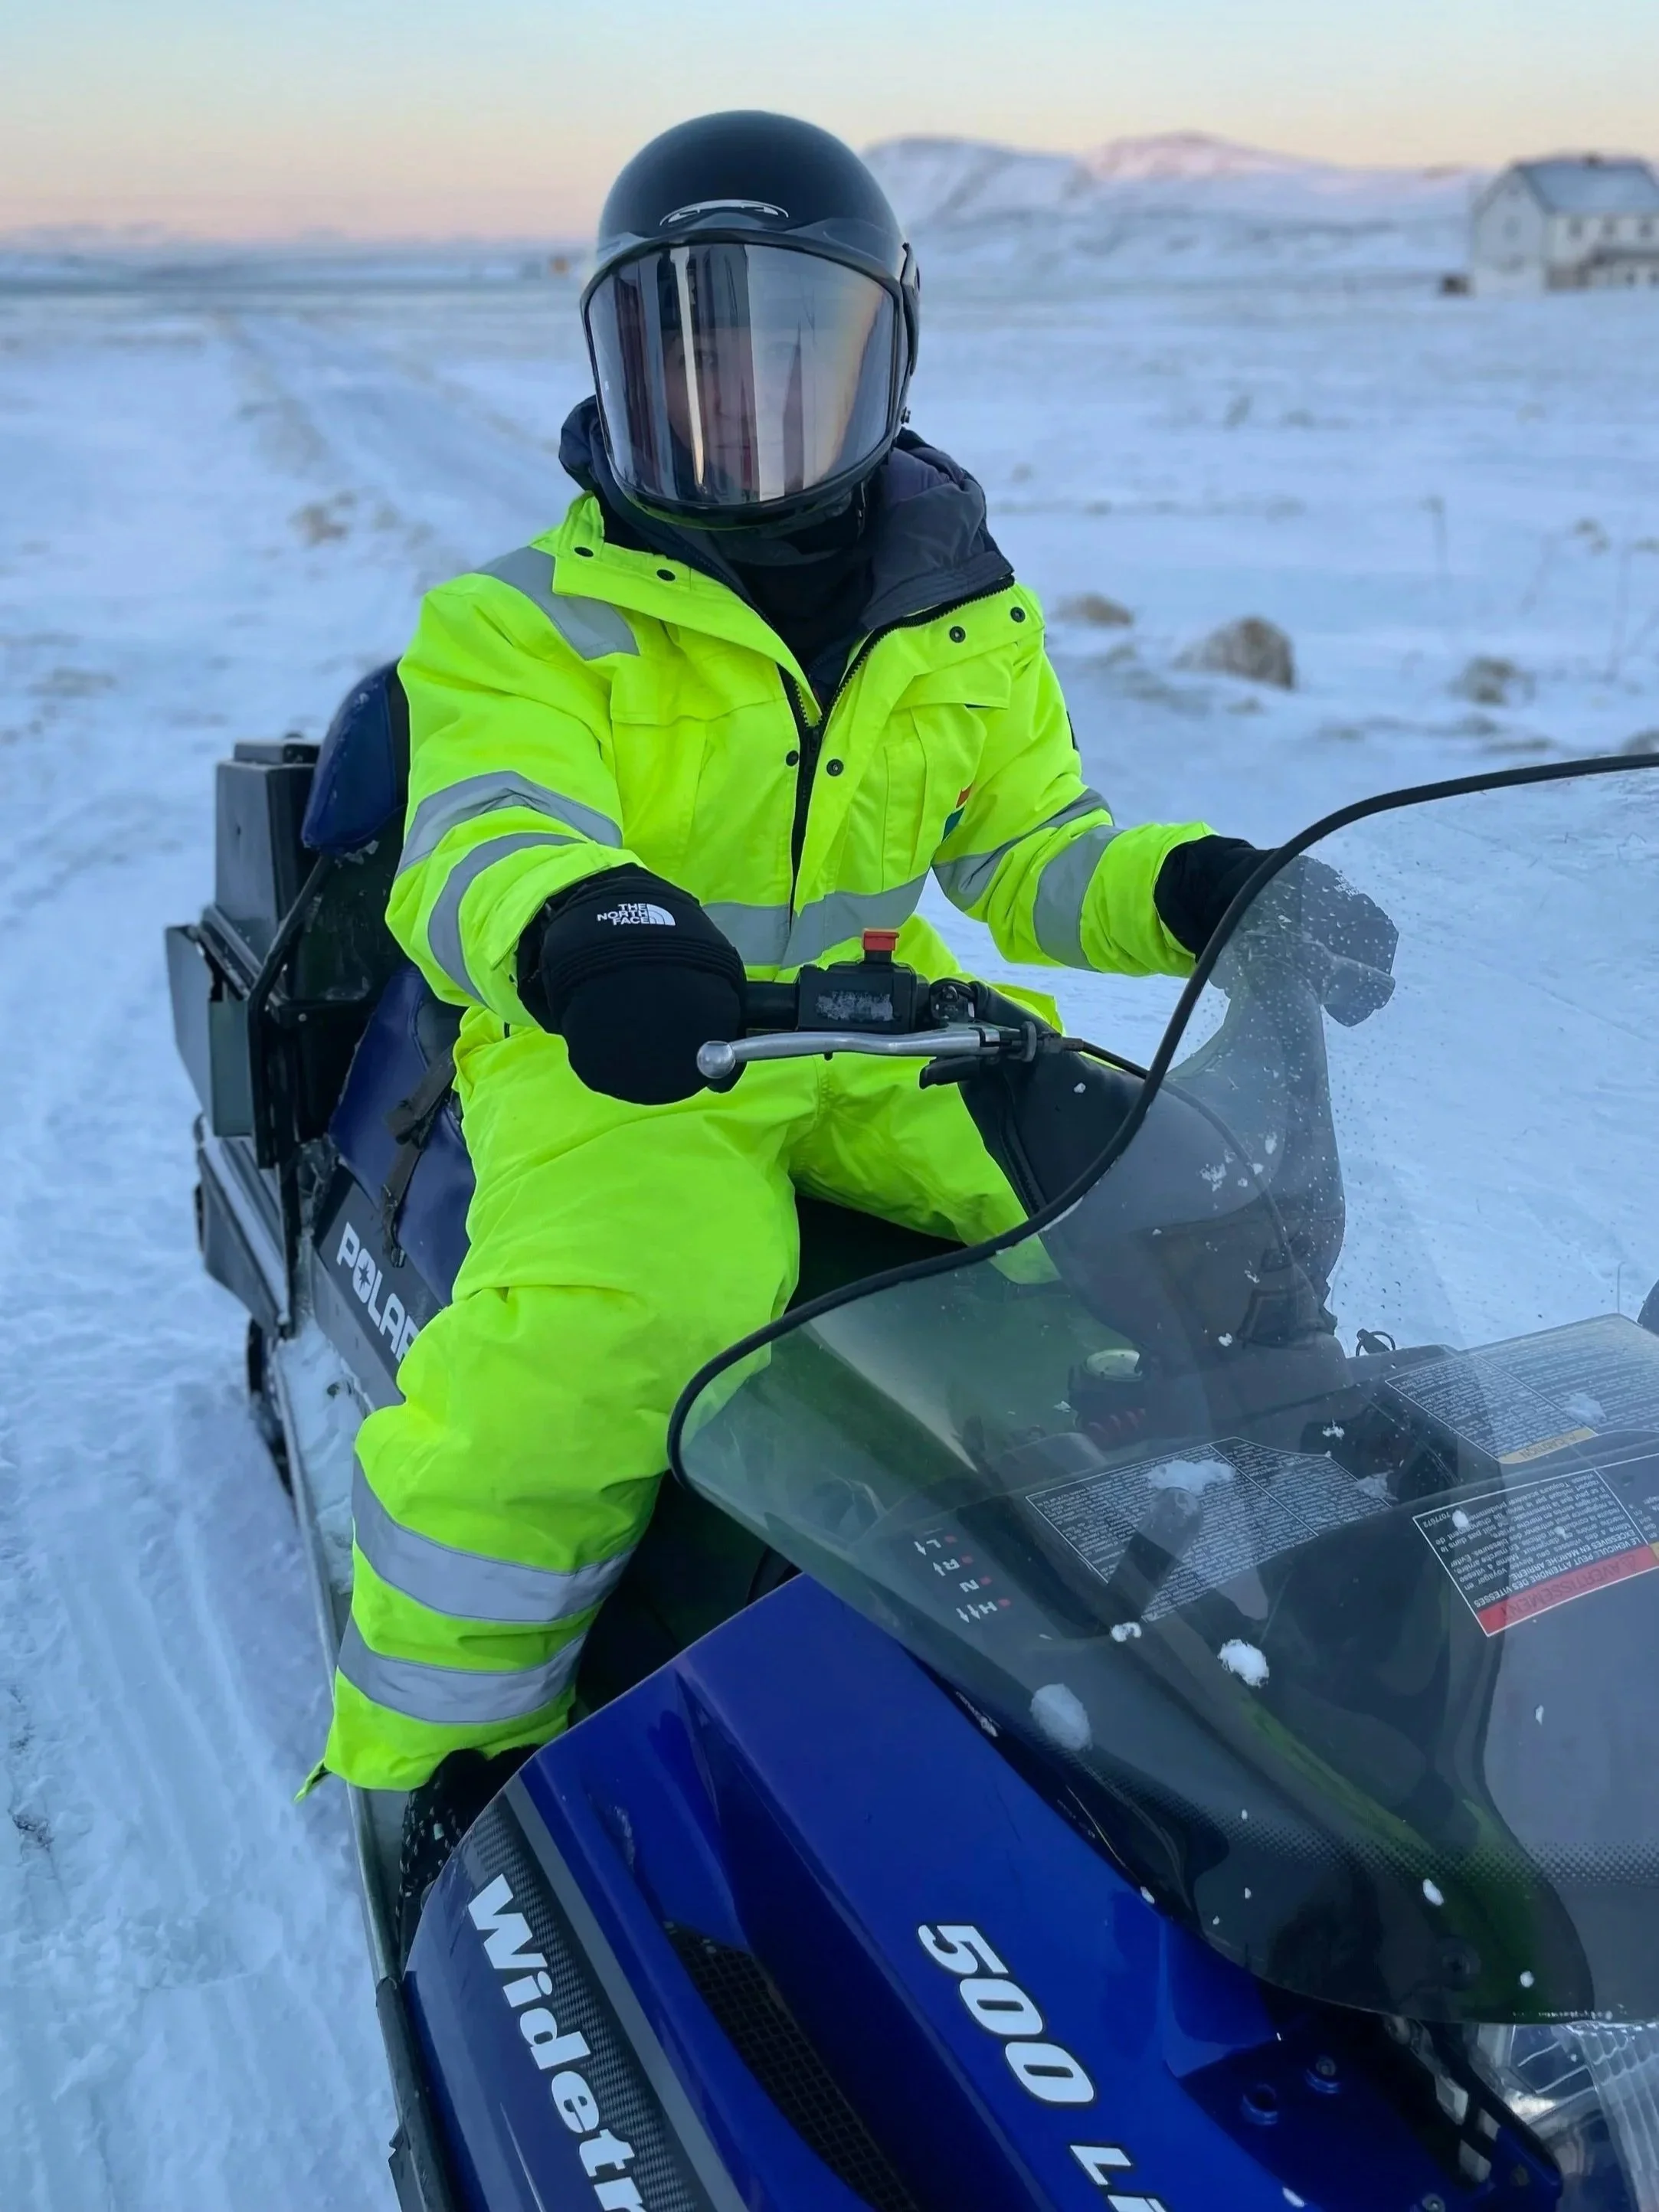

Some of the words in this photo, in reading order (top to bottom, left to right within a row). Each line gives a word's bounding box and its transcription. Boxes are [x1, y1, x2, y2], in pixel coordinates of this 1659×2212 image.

[618, 903, 646, 911] THE
[597, 910, 648, 921] NORTH
[612, 917, 650, 925] FACE
[925, 1538, 942, 1549] L
[1590, 1529, 1636, 1549] EXCESSIVES
[1629, 1536, 1641, 1545] LE
[1507, 1543, 1520, 1552] En
[1578, 1545, 1591, 1553] EN
[1544, 1549, 1580, 1566] MARCHE
[1572, 1553, 1595, 1566] PEUT
[942, 1558, 960, 1571] R
[1526, 1561, 1574, 1582] ATTEINDRE
[959, 1579, 980, 1593] N
[1462, 1582, 1474, 1590] en
[1497, 1560, 1625, 1620] AVERTISSEMENT
[1510, 1578, 1530, 1590] DES
[1471, 1585, 1513, 1607] VITESSES
[977, 1601, 998, 1615] H
[918, 1925, 1094, 2102] 500
